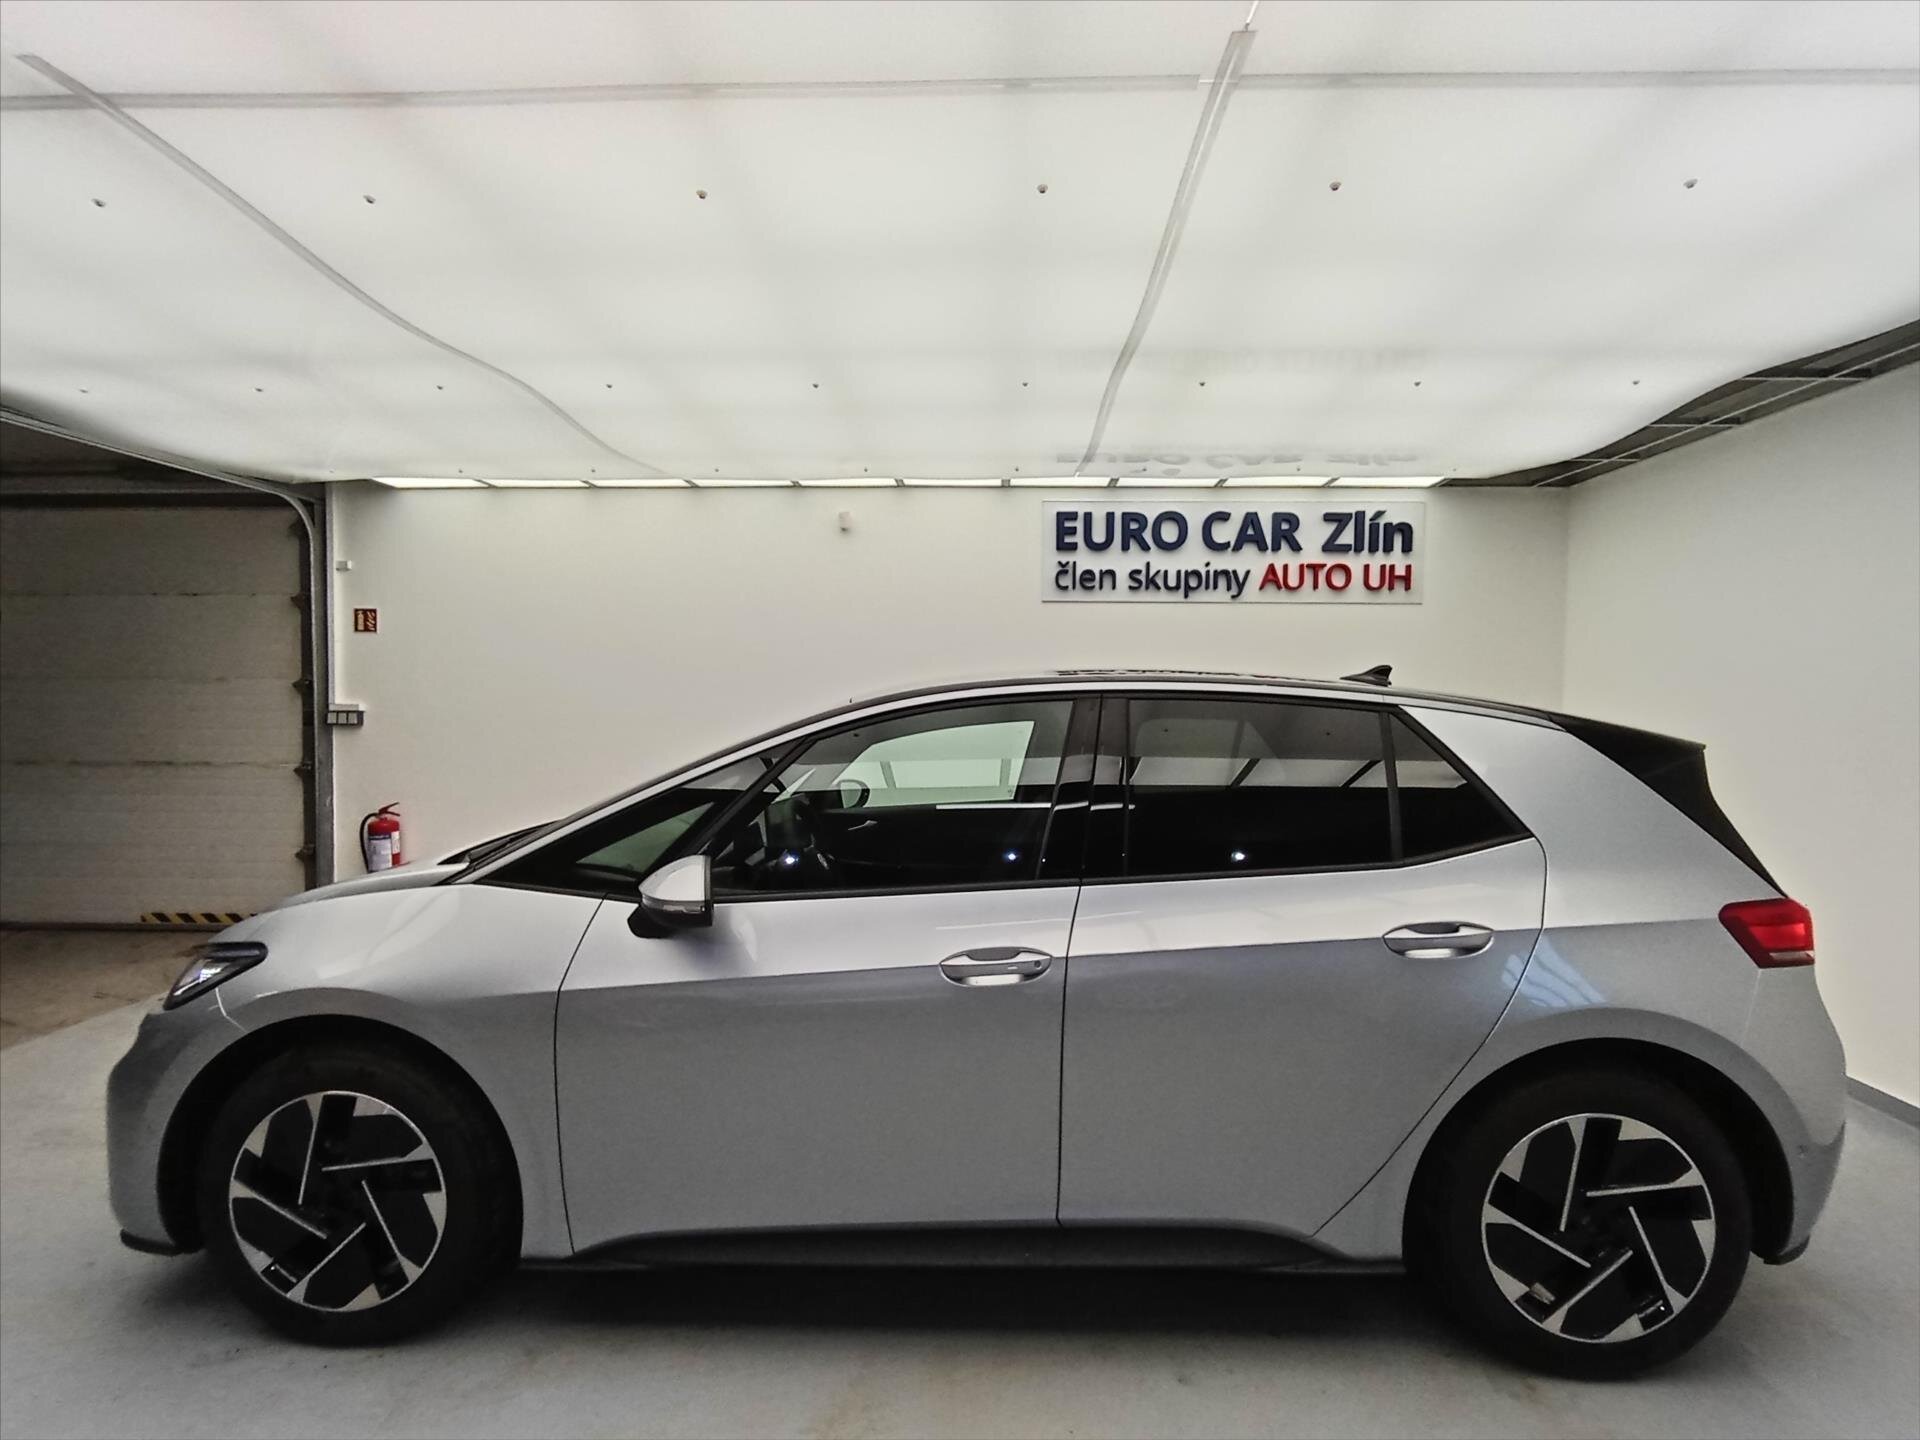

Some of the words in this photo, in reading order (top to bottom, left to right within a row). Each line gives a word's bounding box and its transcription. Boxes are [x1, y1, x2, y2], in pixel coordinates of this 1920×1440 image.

[1056, 511, 1188, 552] EURO
[1202, 511, 1302, 553] CAR
[1322, 510, 1413, 554] Zlín
[1055, 561, 1117, 591] člen
[1259, 562, 1351, 592] AUTO
[1363, 563, 1412, 592] UH
